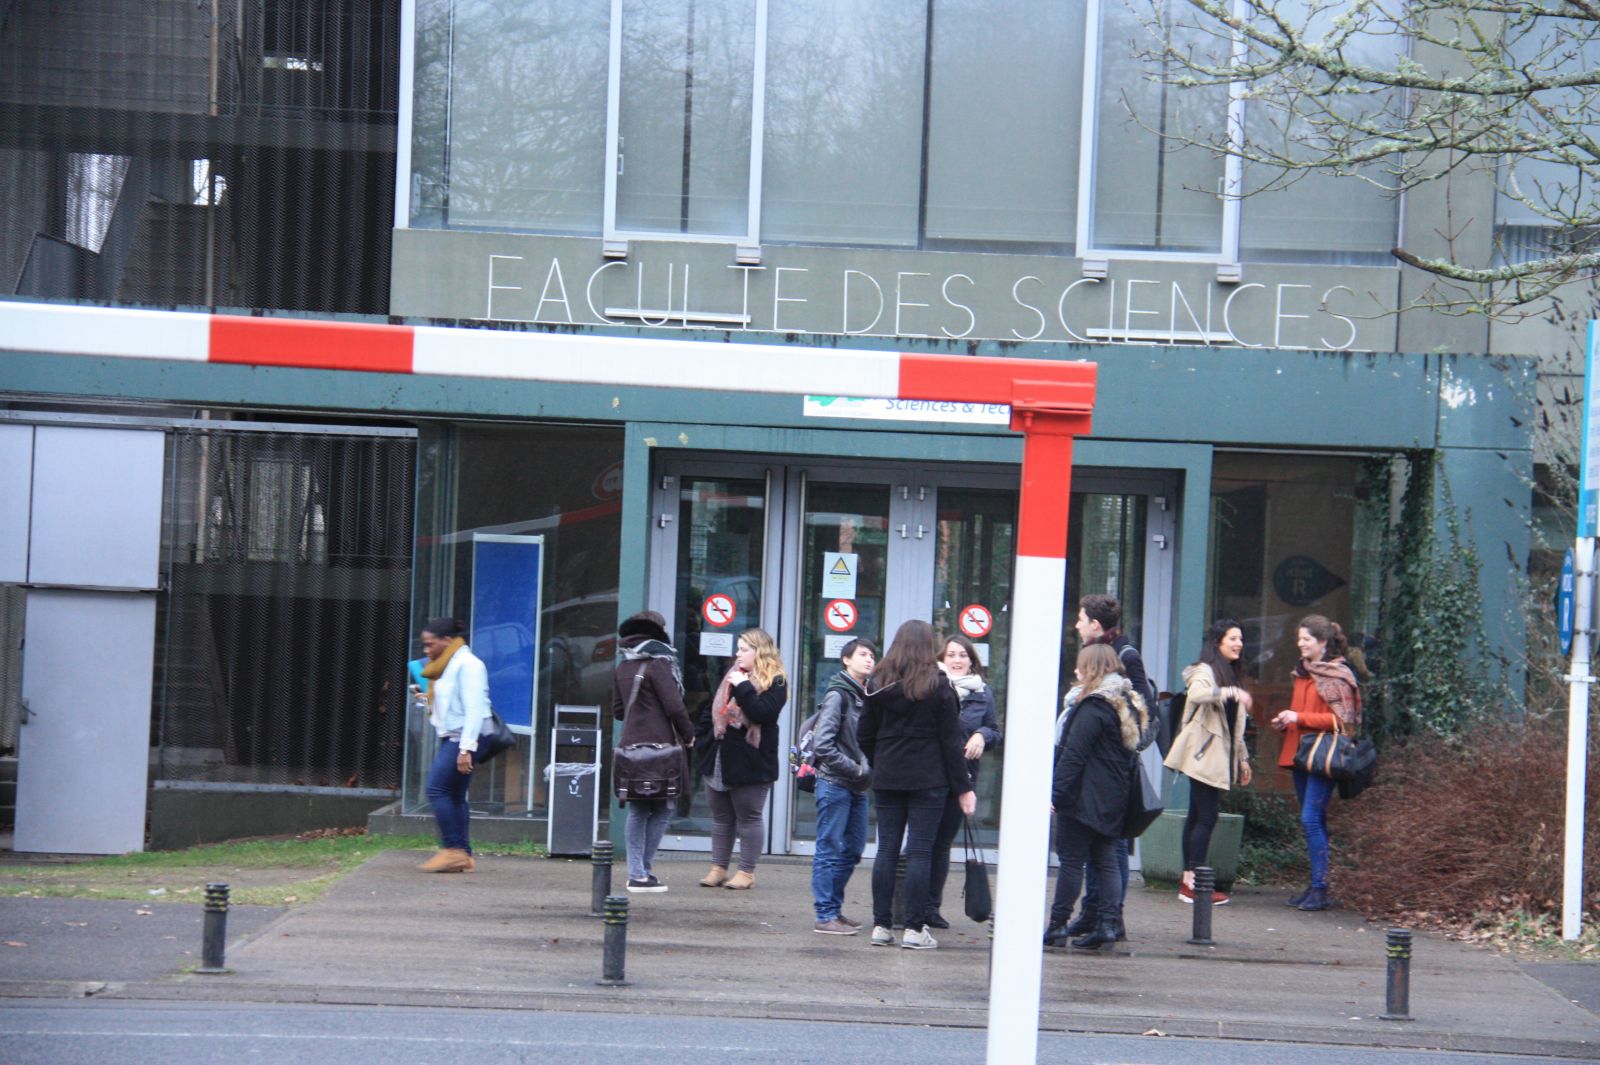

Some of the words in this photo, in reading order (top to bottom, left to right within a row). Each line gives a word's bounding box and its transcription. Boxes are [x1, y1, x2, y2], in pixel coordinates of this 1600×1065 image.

[487, 254, 809, 331] FACULTE
[843, 268, 976, 339] DES
[1011, 275, 1357, 351] SCIENCES
[885, 399, 957, 413] Sciences
[962, 404, 975, 414] &
